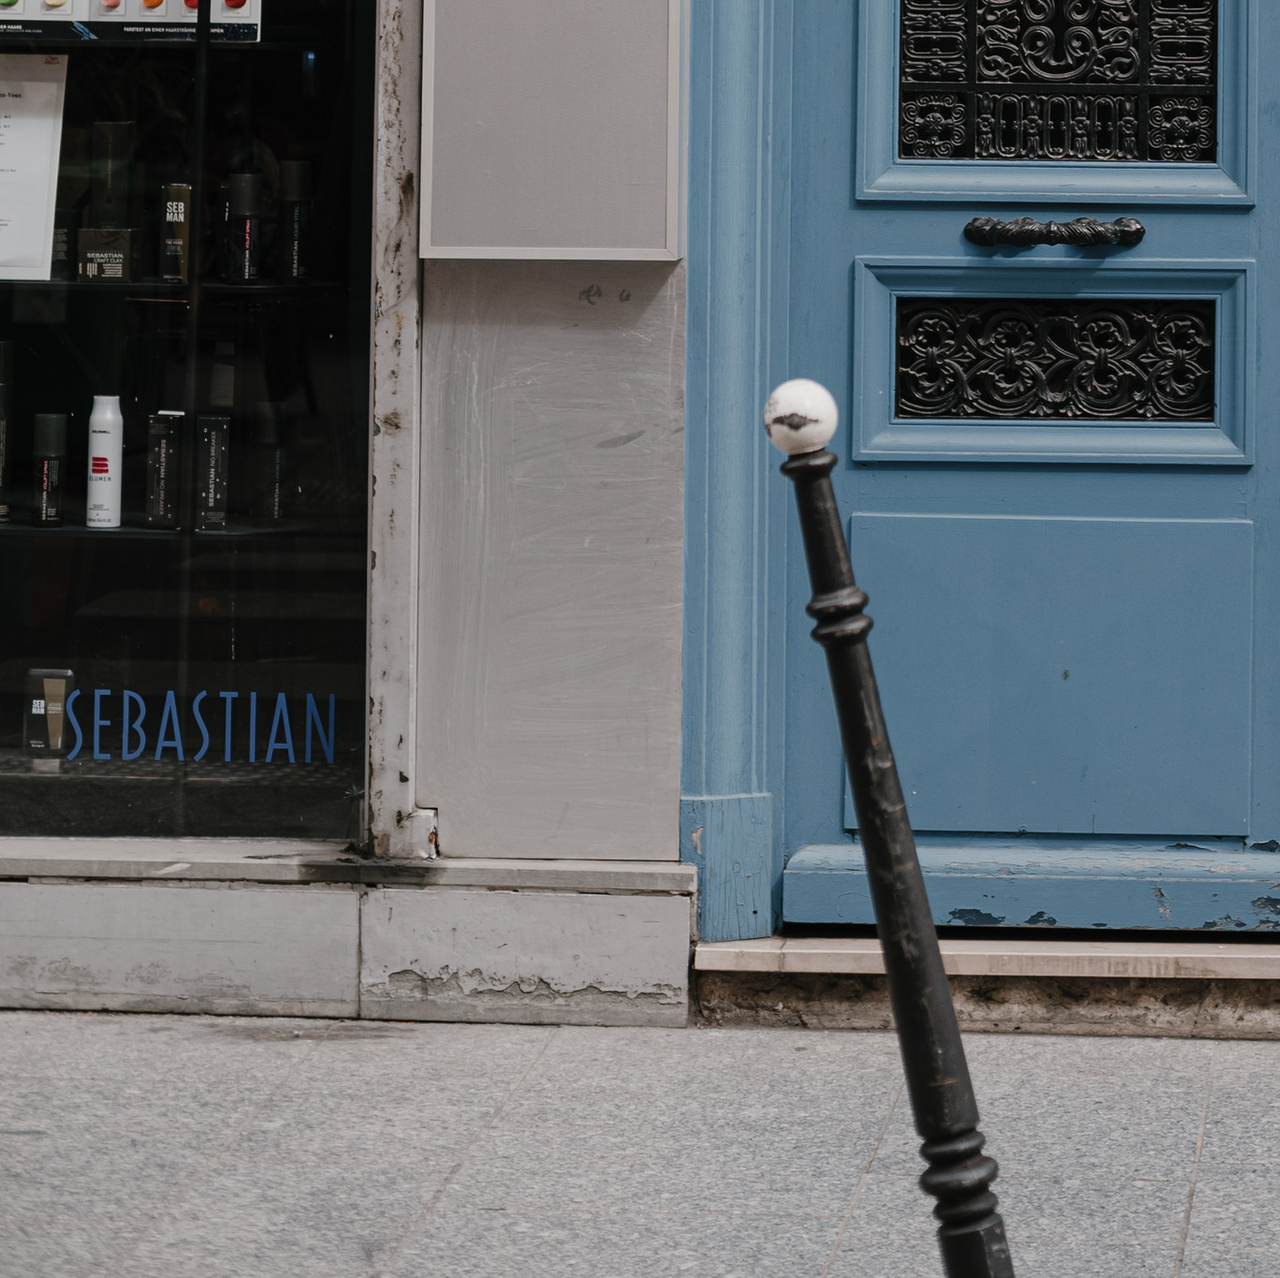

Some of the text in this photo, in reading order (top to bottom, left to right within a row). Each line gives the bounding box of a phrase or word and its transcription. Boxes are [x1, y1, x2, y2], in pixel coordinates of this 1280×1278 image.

[165, 212, 185, 223] MAN
[166, 201, 185, 213] SEB
[159, 439, 167, 478] SEBASTIAN
[208, 468, 216, 508] SEBASTIAN
[66, 688, 336, 764] SEBASTIAN
